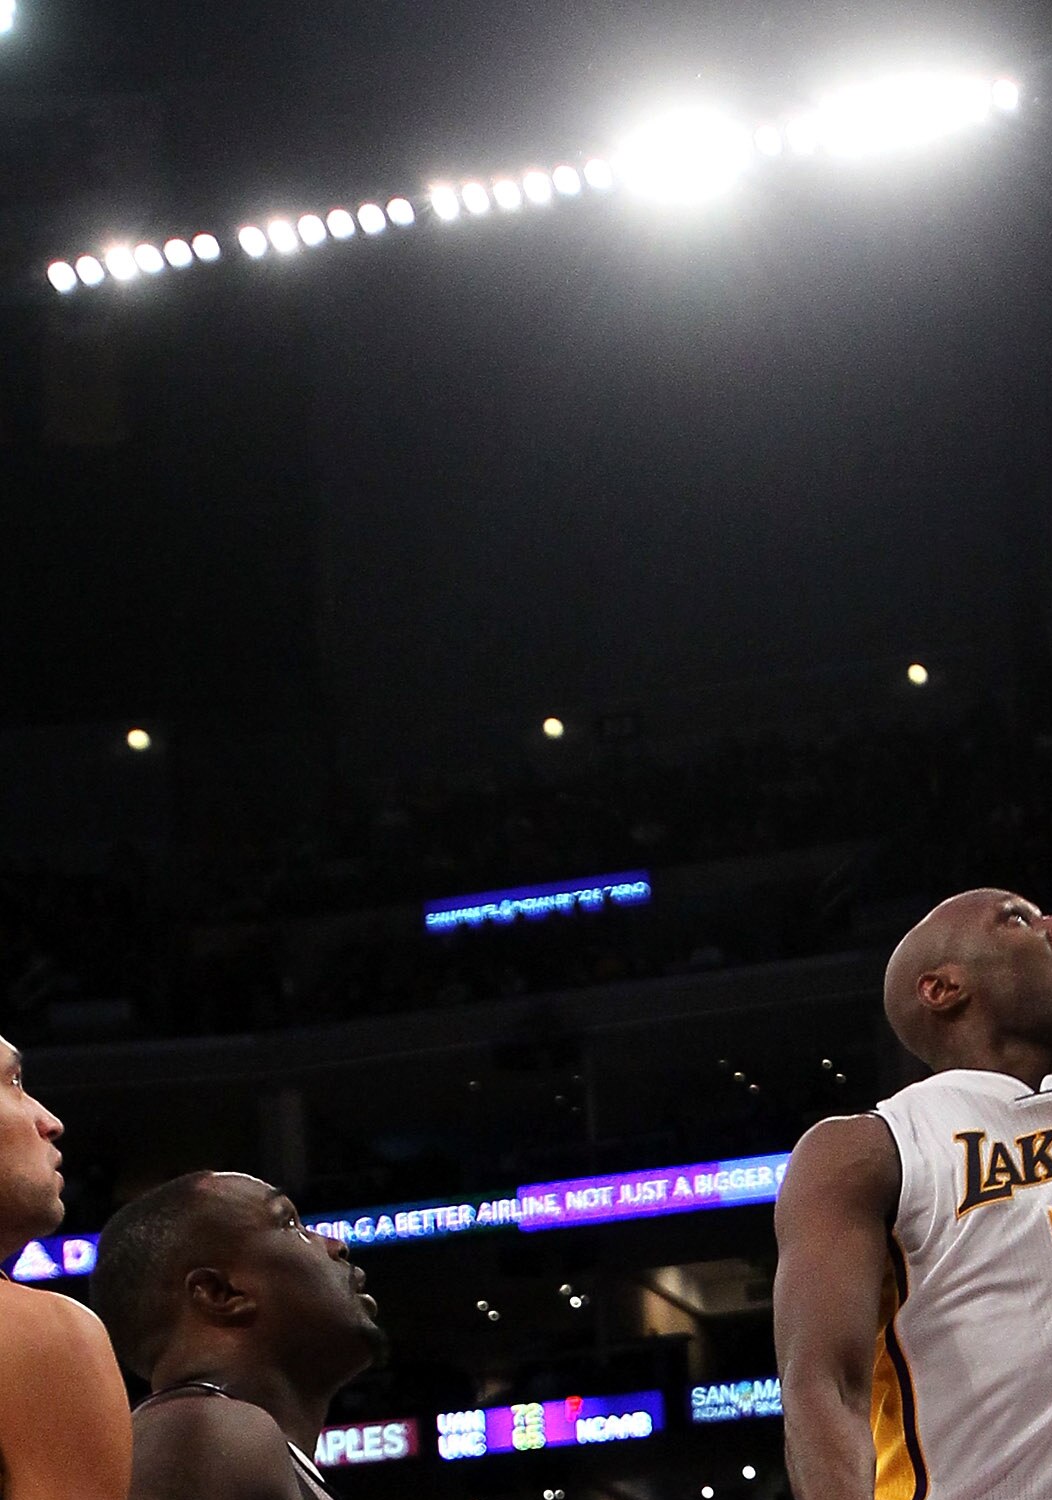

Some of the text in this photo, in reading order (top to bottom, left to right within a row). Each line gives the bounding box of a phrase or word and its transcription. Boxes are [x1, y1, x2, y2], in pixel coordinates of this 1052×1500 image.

[375, 1215, 397, 1239] A
[394, 1204, 476, 1238] BETTER
[566, 1186, 613, 1211] NOT
[617, 1179, 669, 1205] JUST
[672, 1175, 694, 1199] A
[695, 1165, 774, 1197] BIGGER
[313, 1422, 407, 1466] APLES
[575, 1411, 652, 1444] NCAAB
